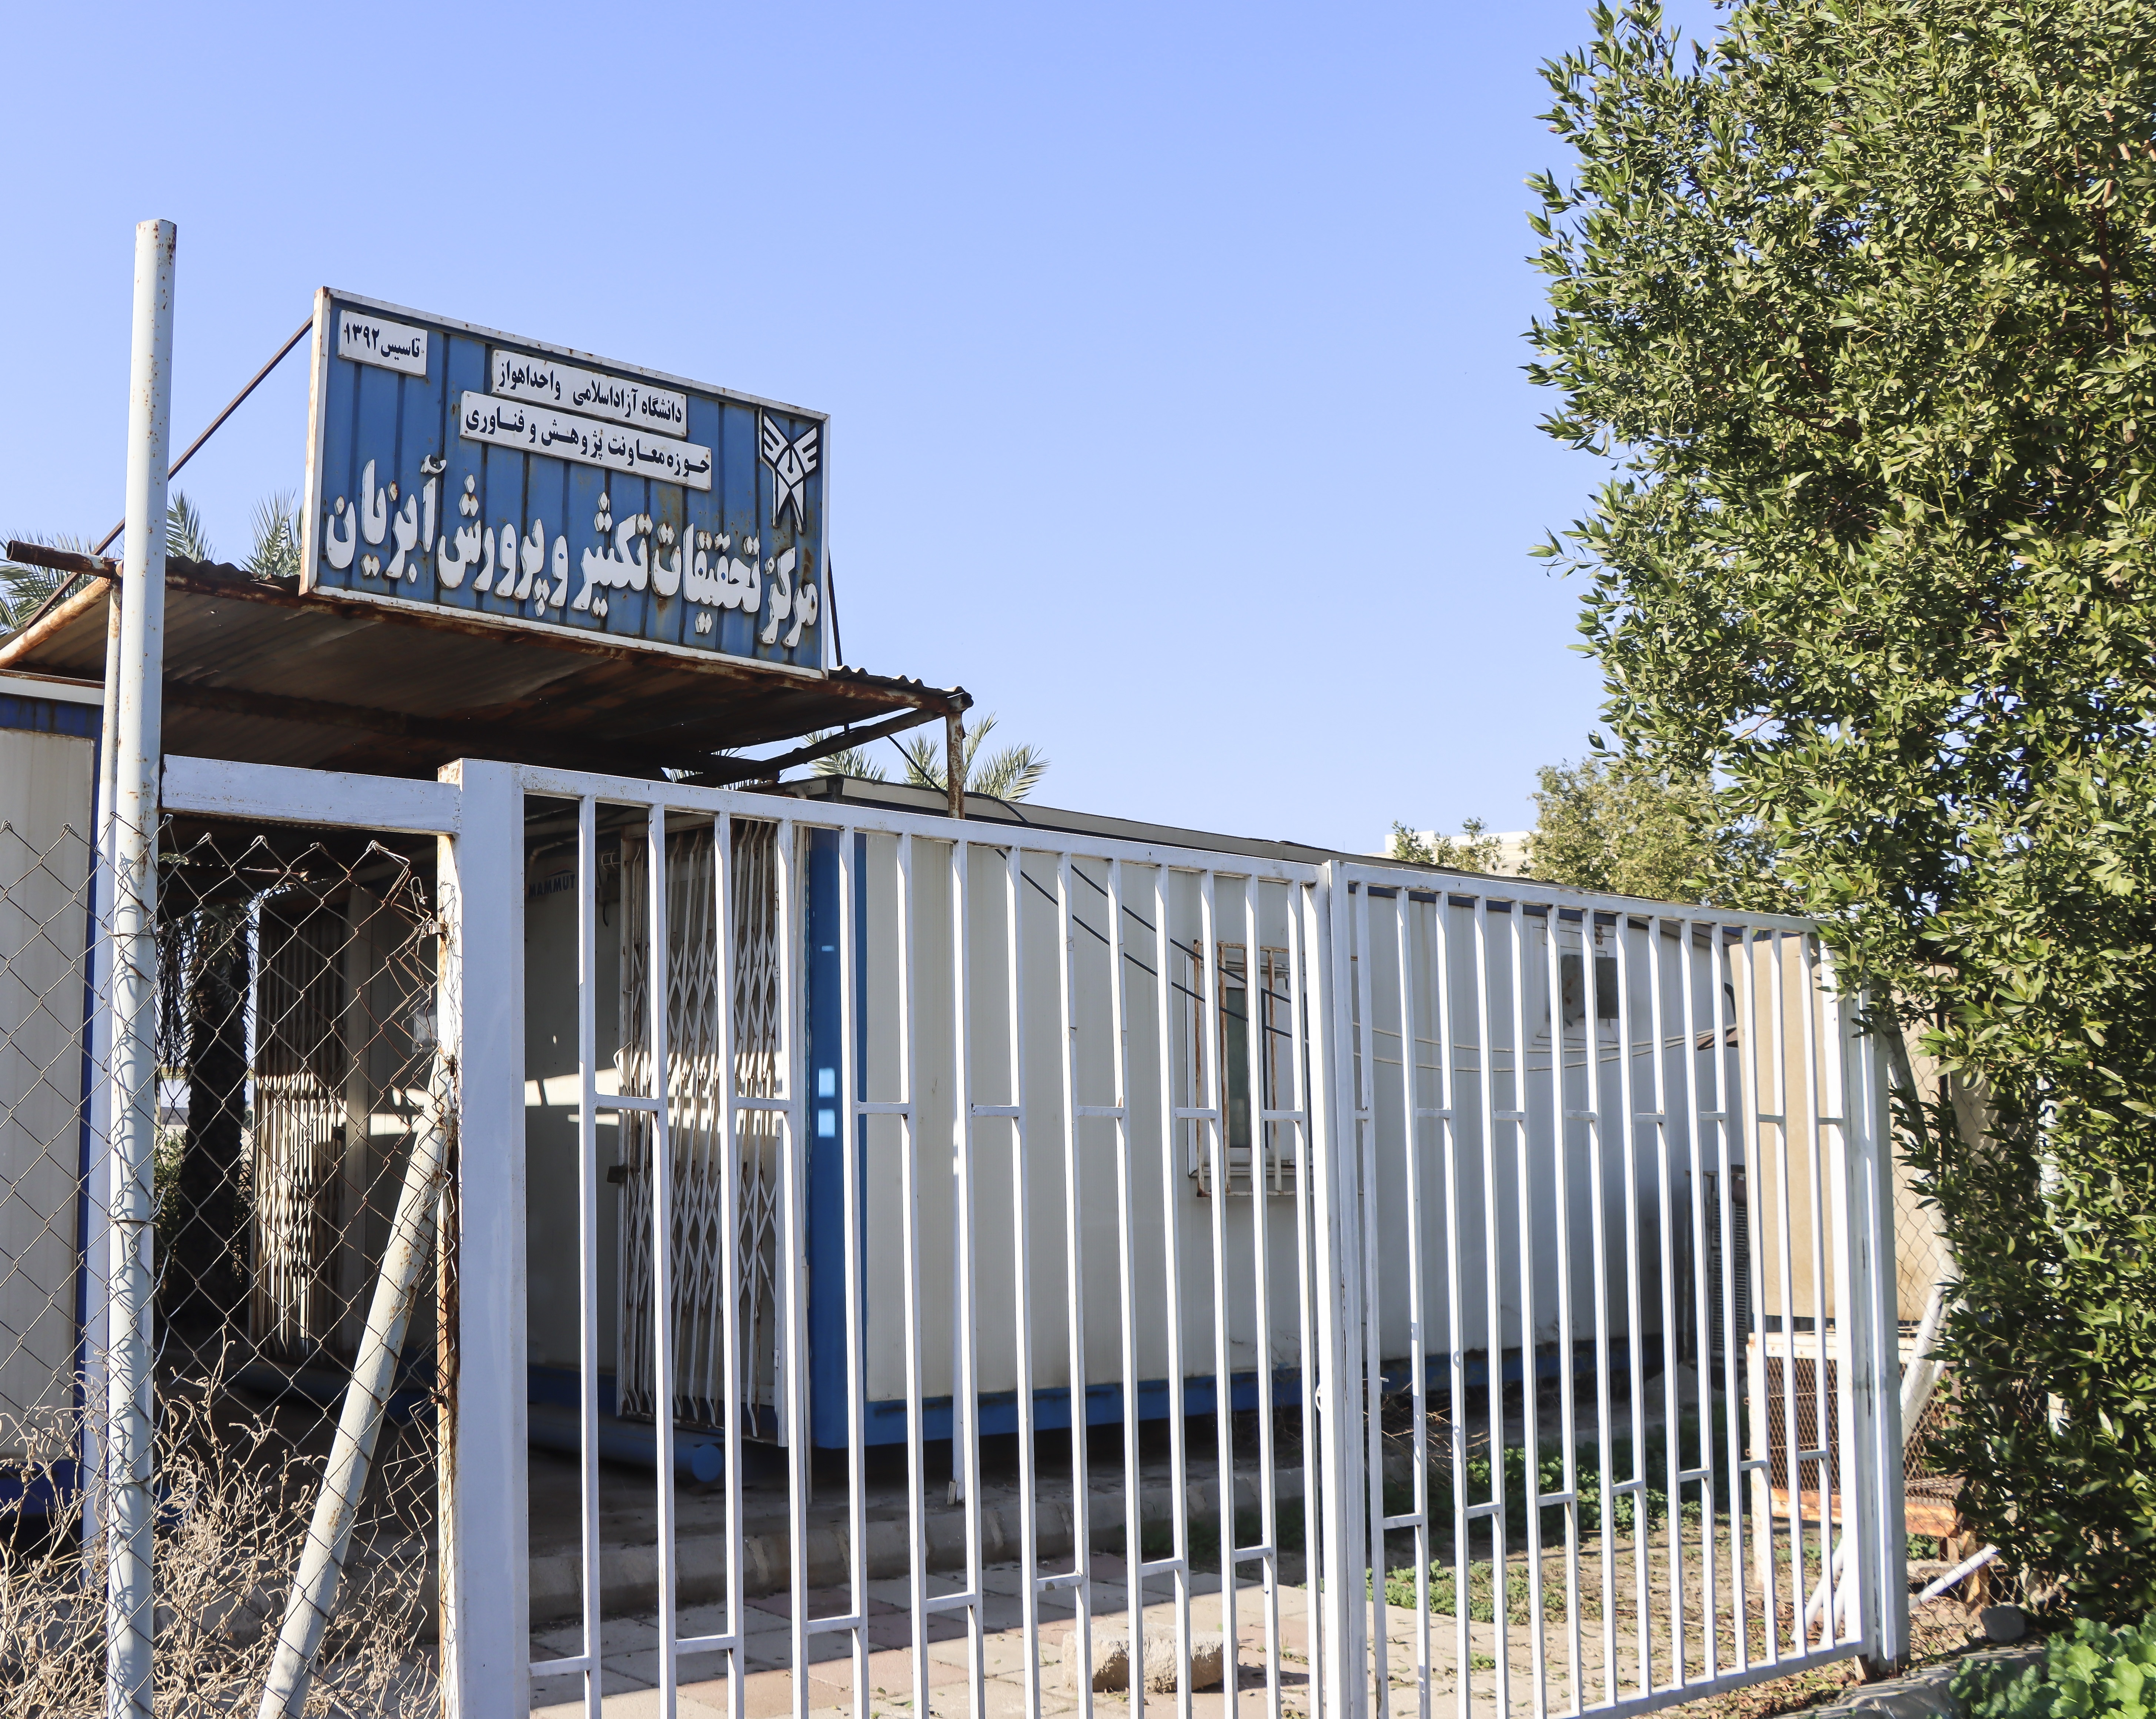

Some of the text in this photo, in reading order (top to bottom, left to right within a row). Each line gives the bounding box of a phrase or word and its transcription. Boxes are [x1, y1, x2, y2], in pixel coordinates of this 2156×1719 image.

[346, 322, 380, 350] ۱۳۹۲
[641, 394, 682, 423] دانشگاه
[465, 405, 710, 477] حوزه معاونت پژوهش و فناوری
[325, 454, 818, 648] مرکز تحقیقات تکثیر و پرورش آبزیان
[528, 873, 576, 898] MAMMUT
